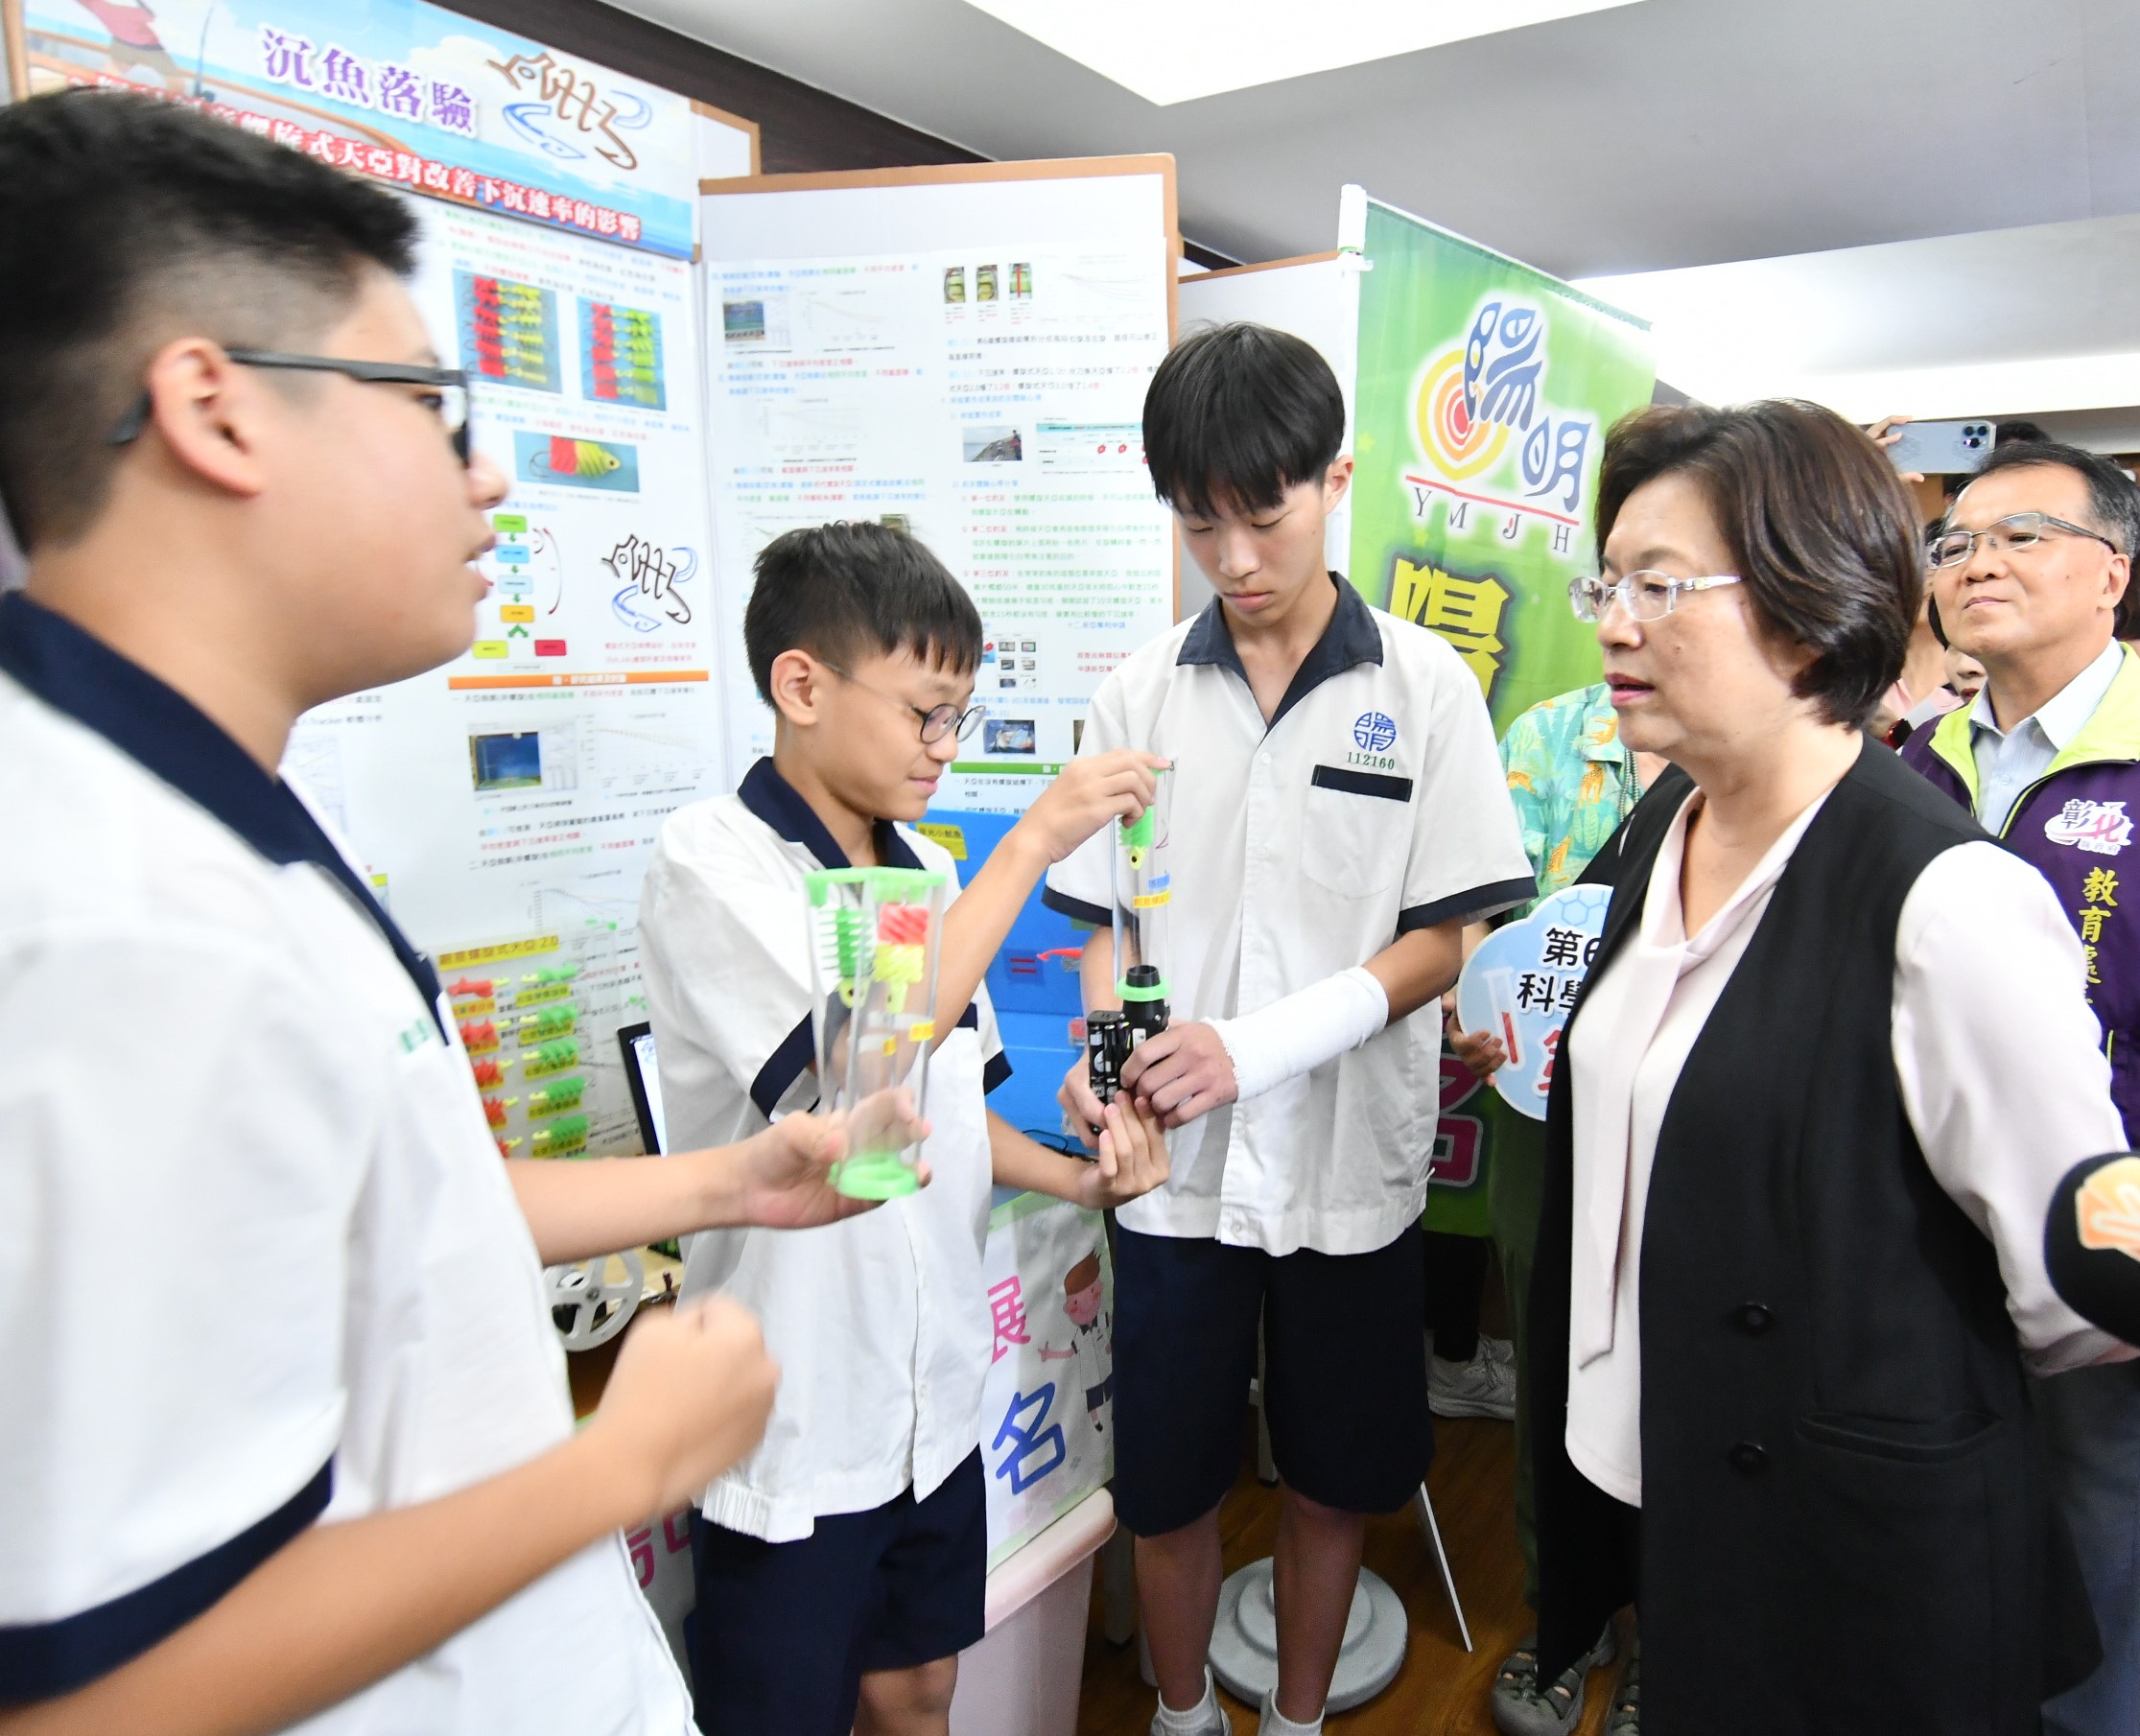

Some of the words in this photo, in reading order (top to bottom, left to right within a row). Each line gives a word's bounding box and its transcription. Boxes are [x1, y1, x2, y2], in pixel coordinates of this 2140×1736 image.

[262, 28, 478, 134] 沉魚落驗
[1347, 752, 1395, 770] 112160
[2079, 866, 2119, 1003] 教育
[992, 1382, 1066, 1495] 名
